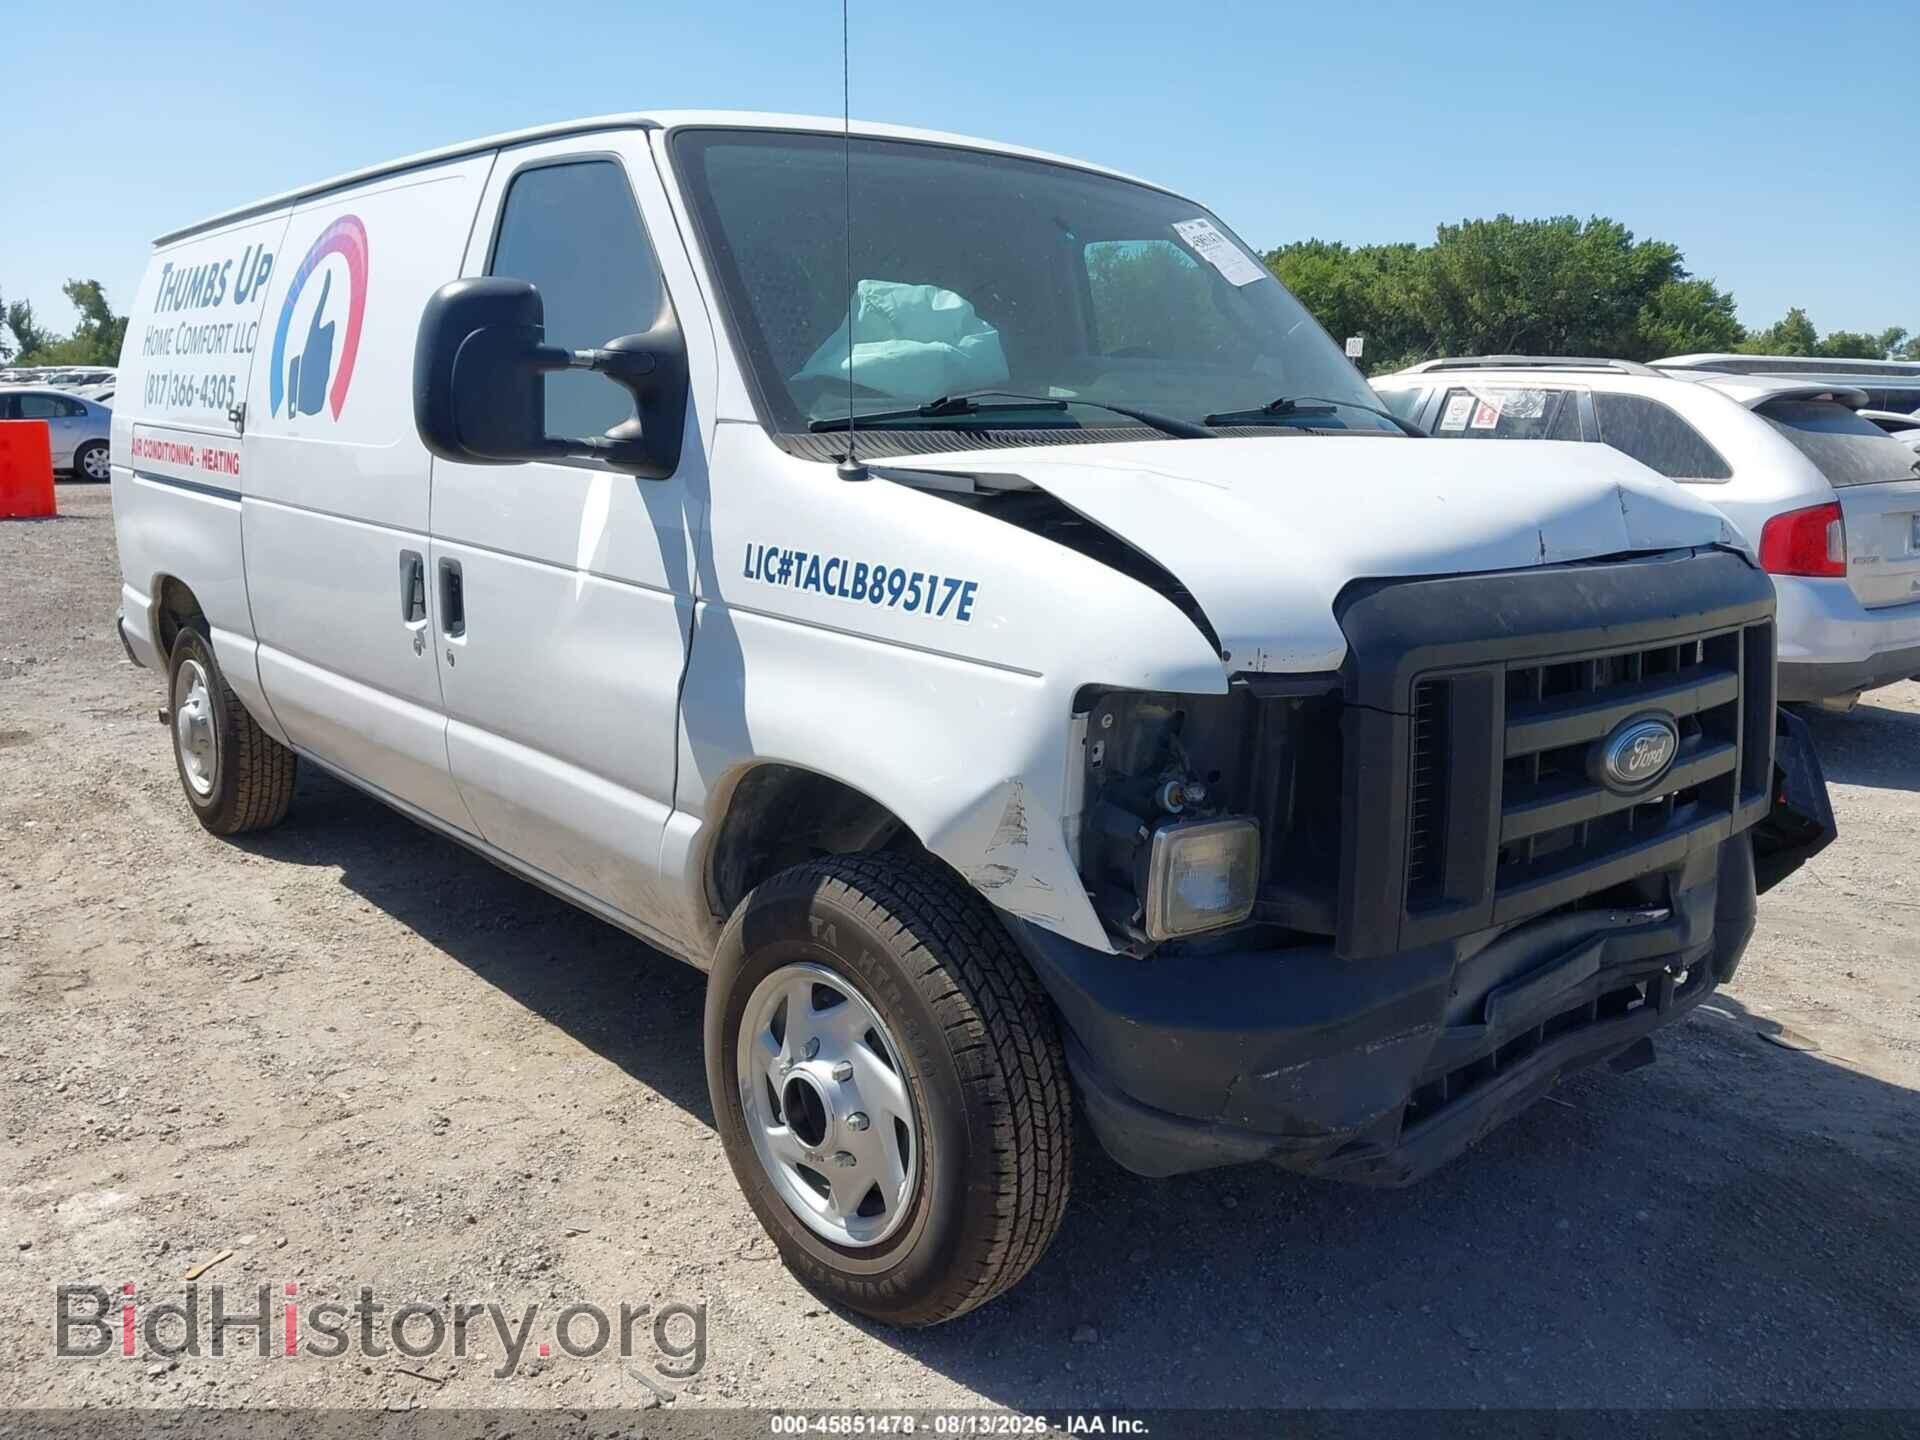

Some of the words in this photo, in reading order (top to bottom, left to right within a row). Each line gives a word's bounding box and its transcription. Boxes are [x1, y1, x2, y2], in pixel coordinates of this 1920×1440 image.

[142, 325, 173, 357] HOME
[175, 321, 233, 356] COMFORT
[232, 321, 257, 354] LLC
[144, 370, 236, 411] (817)366-4305
[131, 437, 143, 456] AIR
[143, 439, 194, 466] CONDITIONING
[201, 448, 240, 475] HEATING
[743, 543, 979, 622] LIC#TACLB89517E
[1629, 734, 1666, 771] Ford
